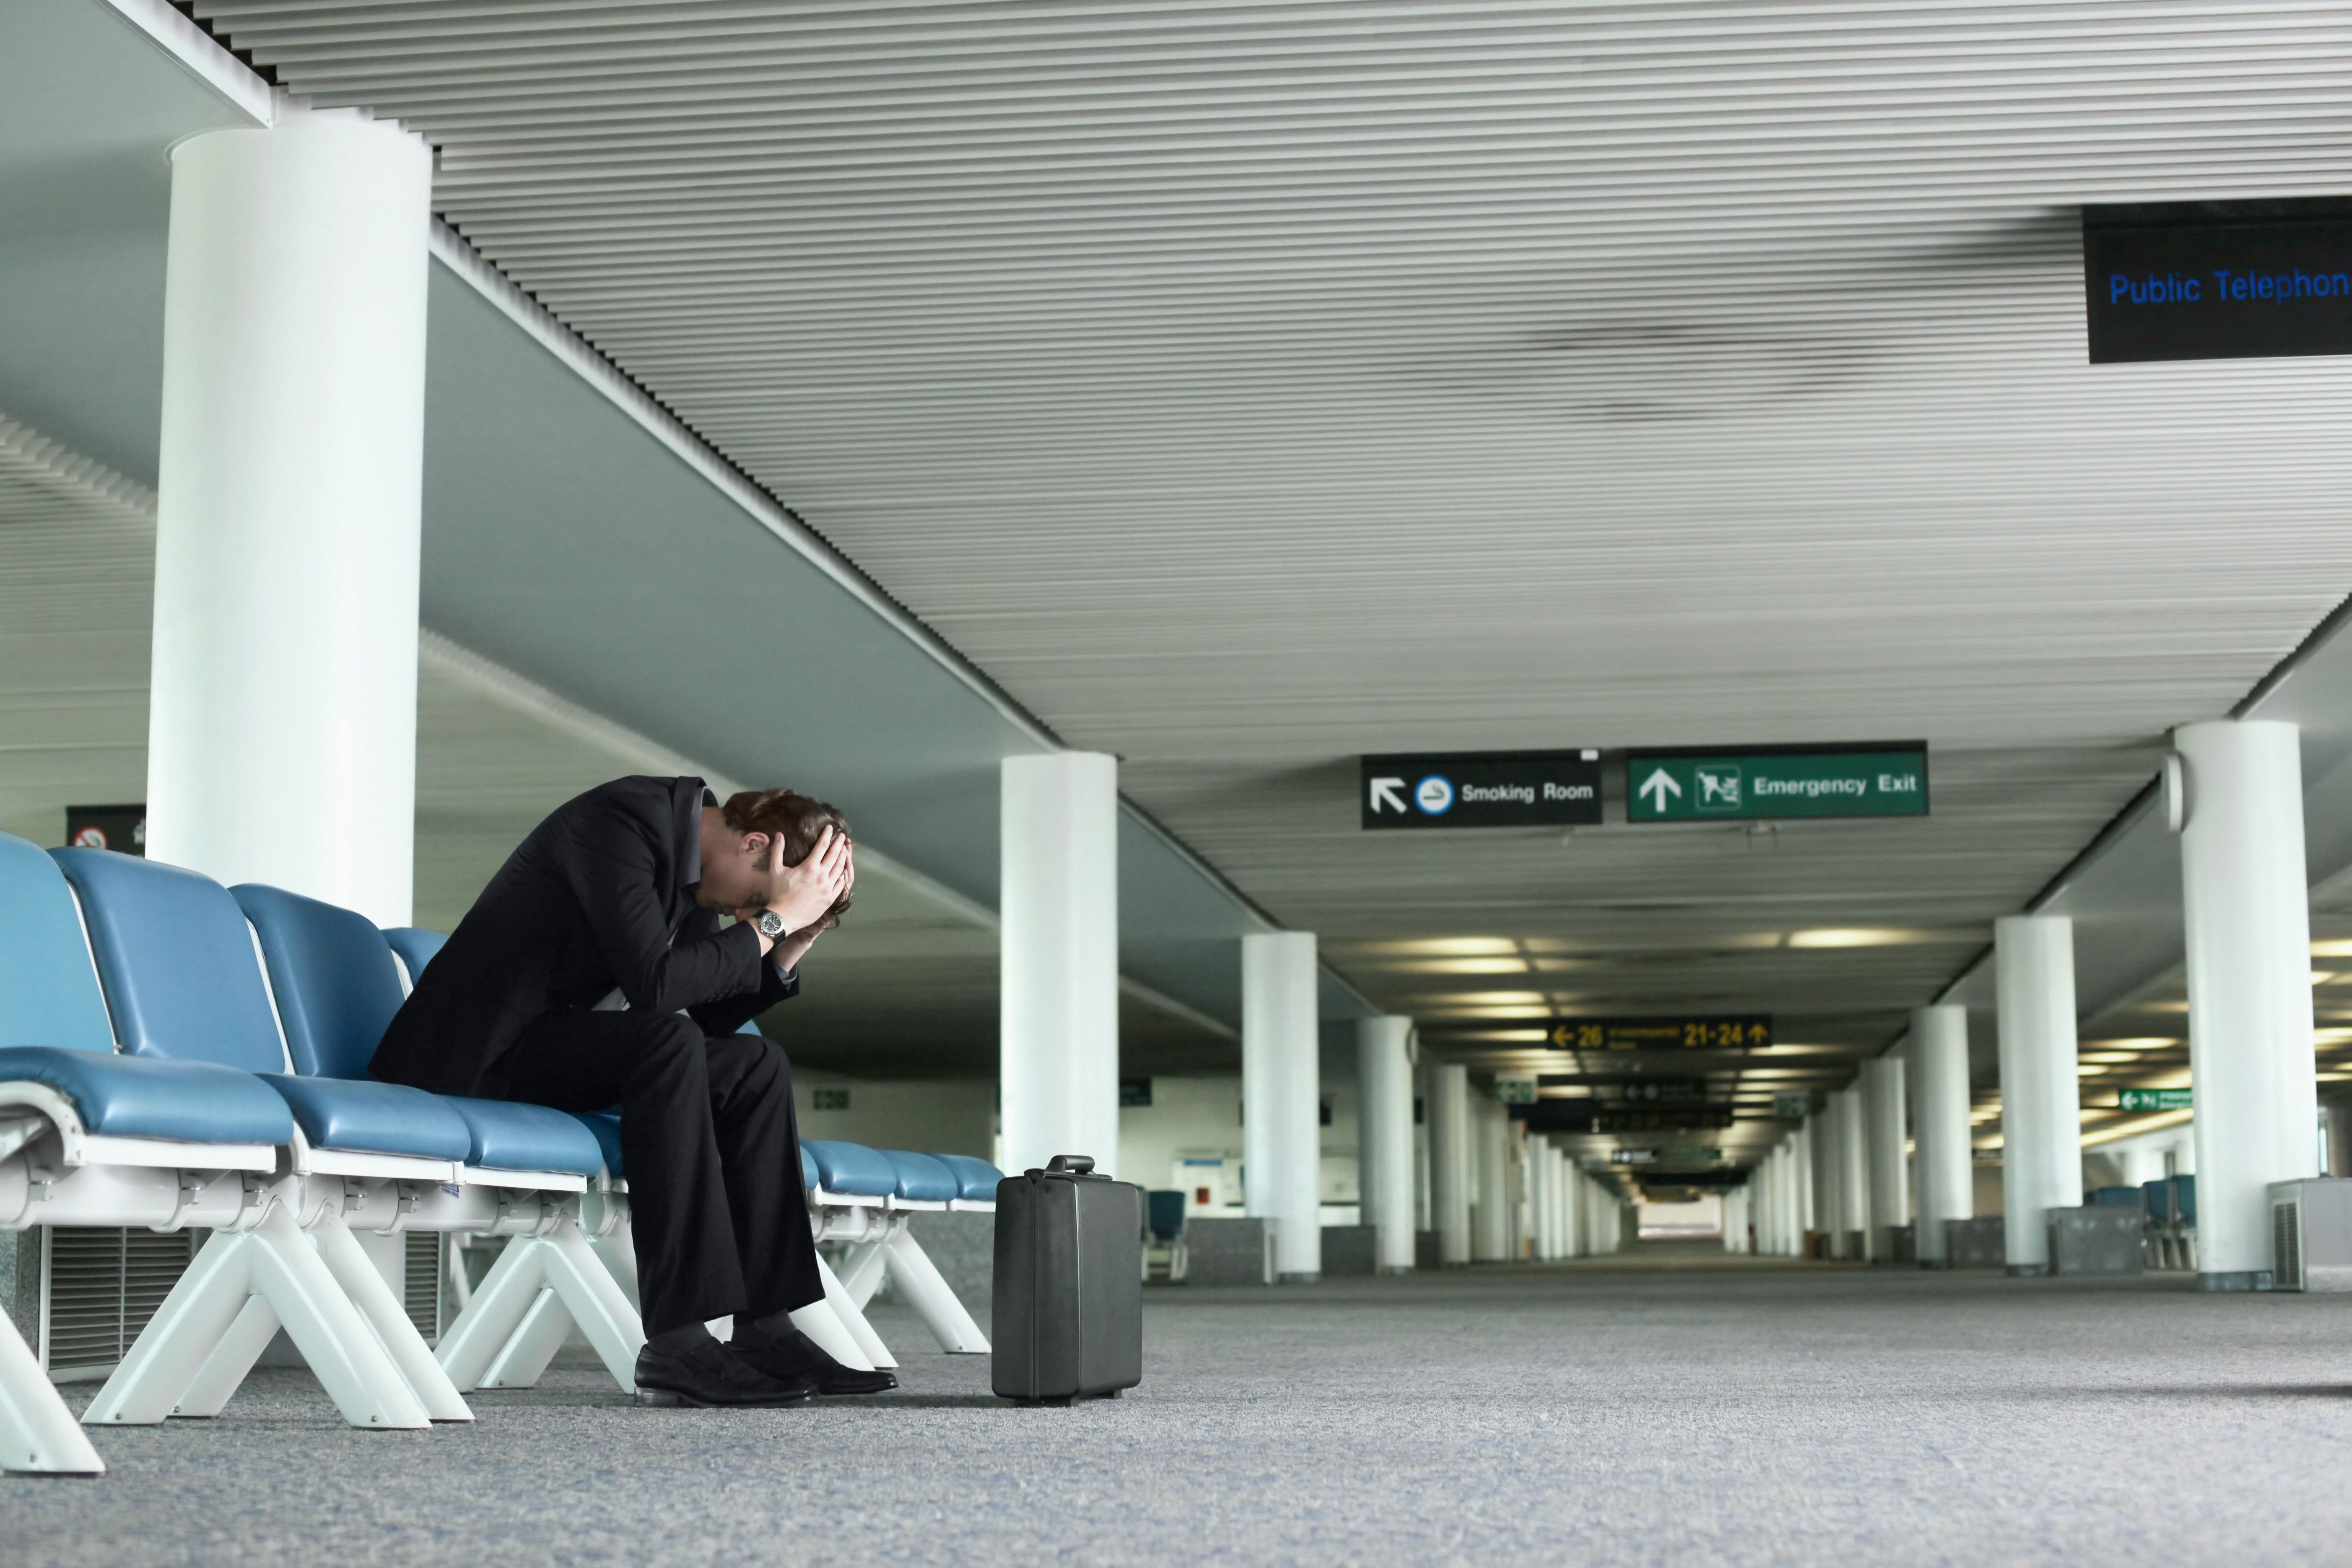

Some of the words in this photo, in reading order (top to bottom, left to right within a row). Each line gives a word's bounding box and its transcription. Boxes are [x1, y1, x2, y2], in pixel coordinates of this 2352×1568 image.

[2111, 273, 2201, 304] Public
[2214, 267, 2352, 304] Telephon
[1462, 784, 1534, 804] Smoking
[1544, 783, 1593, 800] Room
[1755, 777, 1867, 797] Emergency
[1878, 775, 1916, 792] Exit
[1685, 1024, 1743, 1046] 21-24
